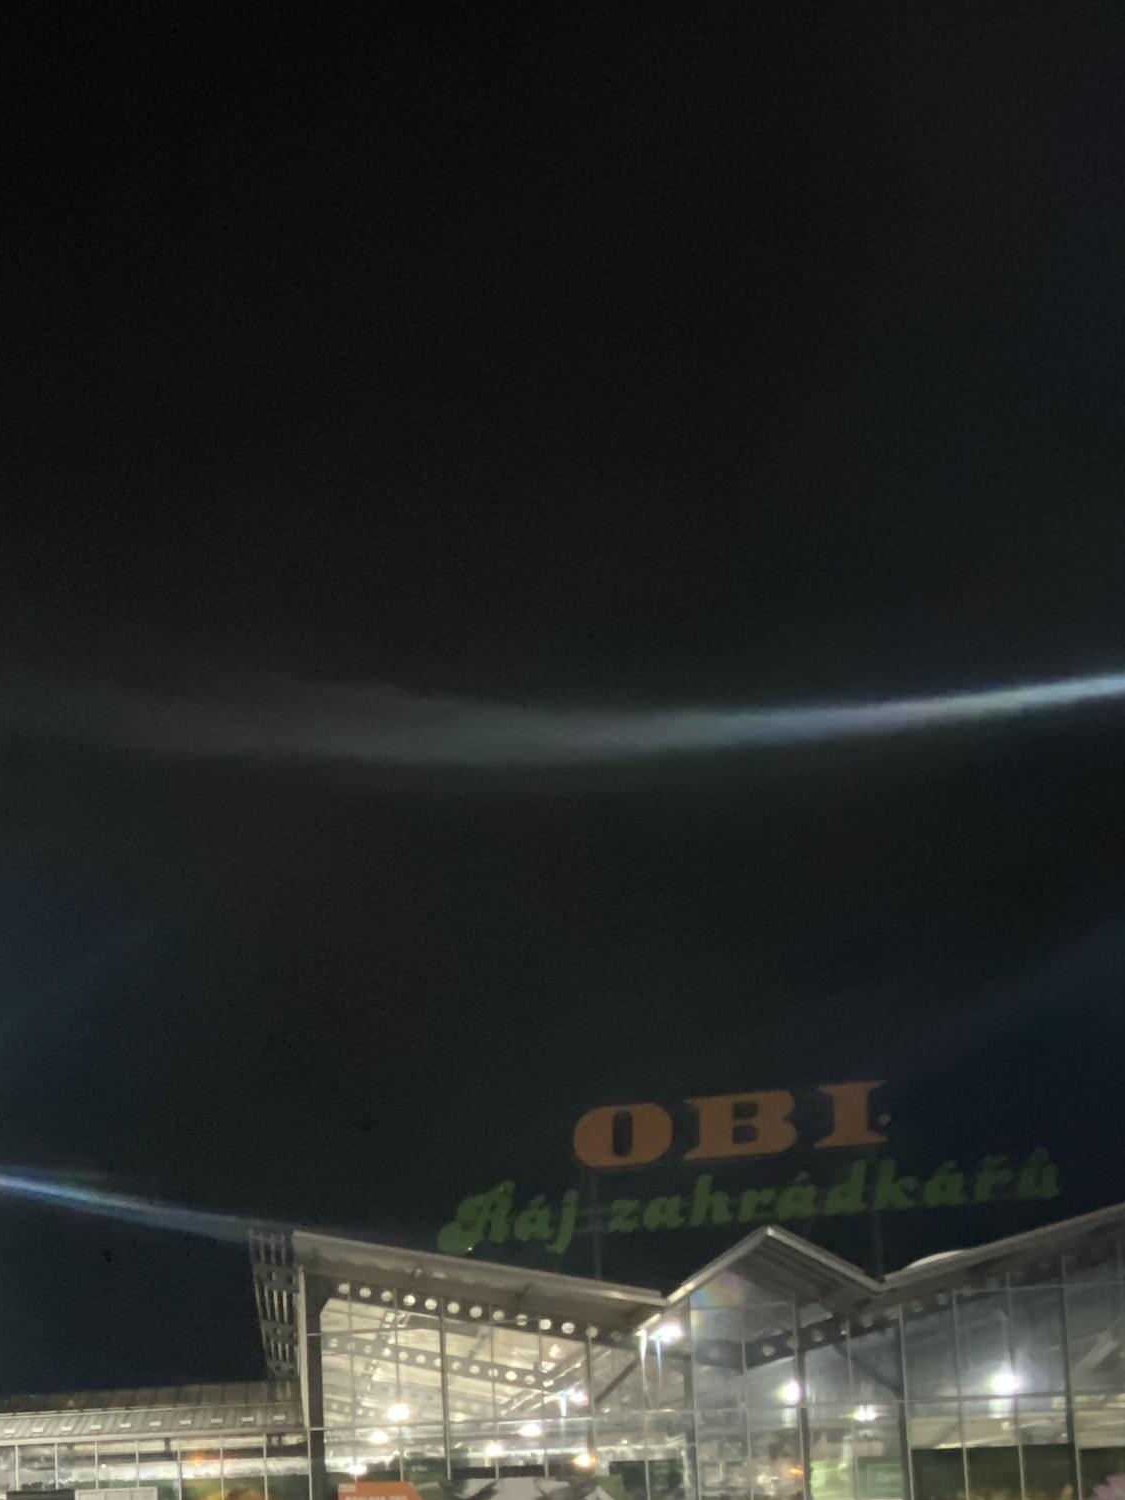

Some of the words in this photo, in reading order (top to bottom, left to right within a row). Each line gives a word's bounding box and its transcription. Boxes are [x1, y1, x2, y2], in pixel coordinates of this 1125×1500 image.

[574, 1080, 888, 1168] OBI
[436, 1180, 577, 1255] Ráj
[608, 1147, 1062, 1233] zahrádkářů
